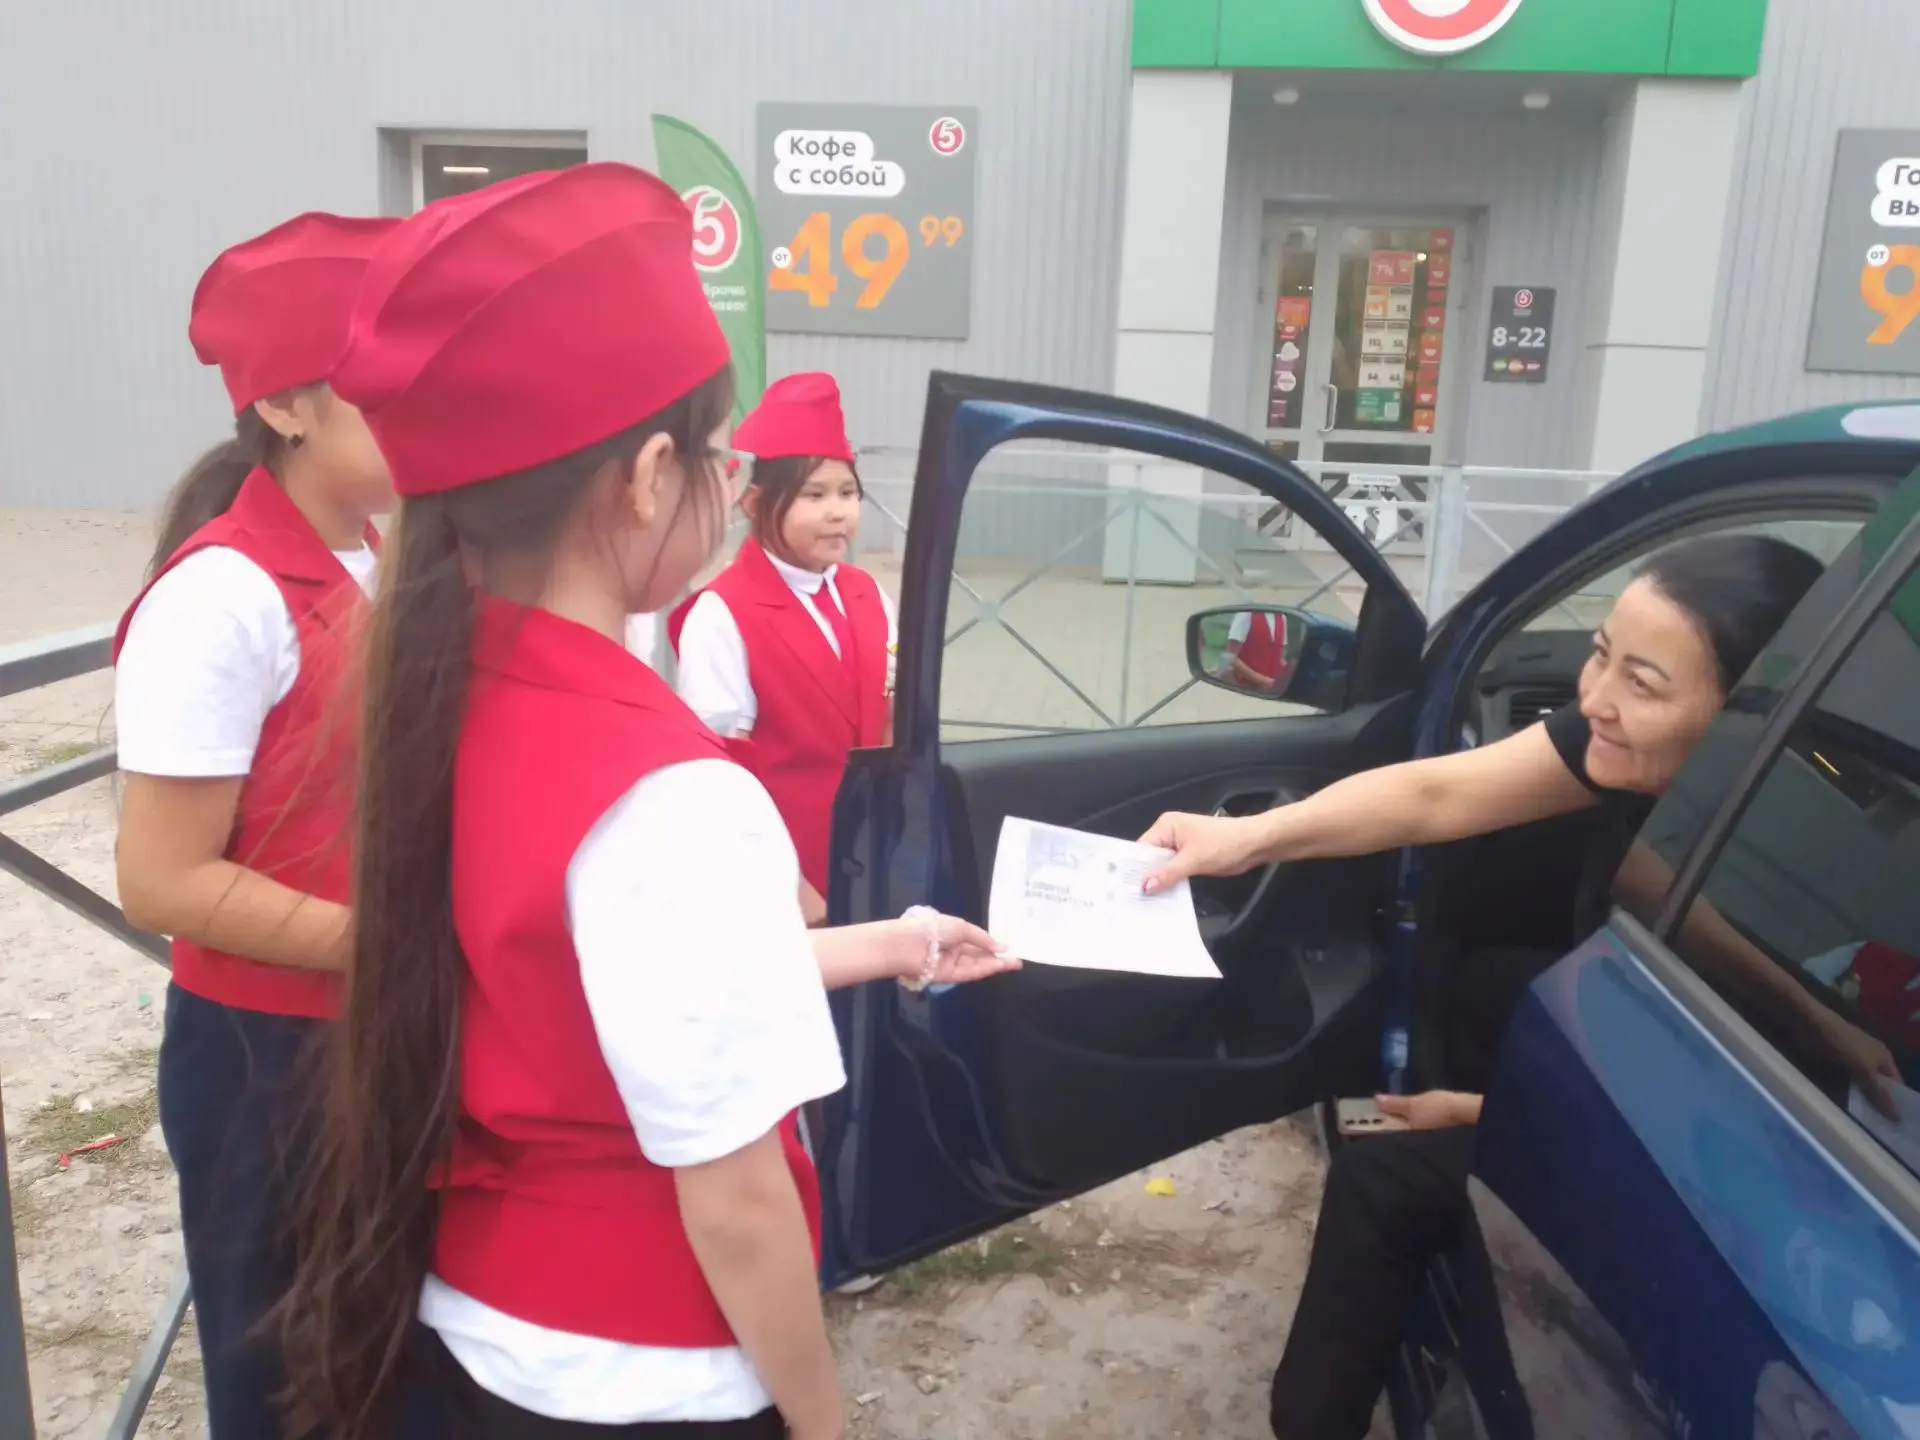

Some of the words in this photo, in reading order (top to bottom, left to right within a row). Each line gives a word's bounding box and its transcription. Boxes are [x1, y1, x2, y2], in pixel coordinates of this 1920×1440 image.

[789, 136, 857, 160] Кофе
[789, 167, 801, 184] с
[810, 163, 887, 186] собой
[919, 215, 963, 247] 99
[768, 211, 910, 309] 49
[775, 253, 788, 262] от
[1870, 250, 1886, 260] от
[1492, 326, 1546, 347] 8-22
